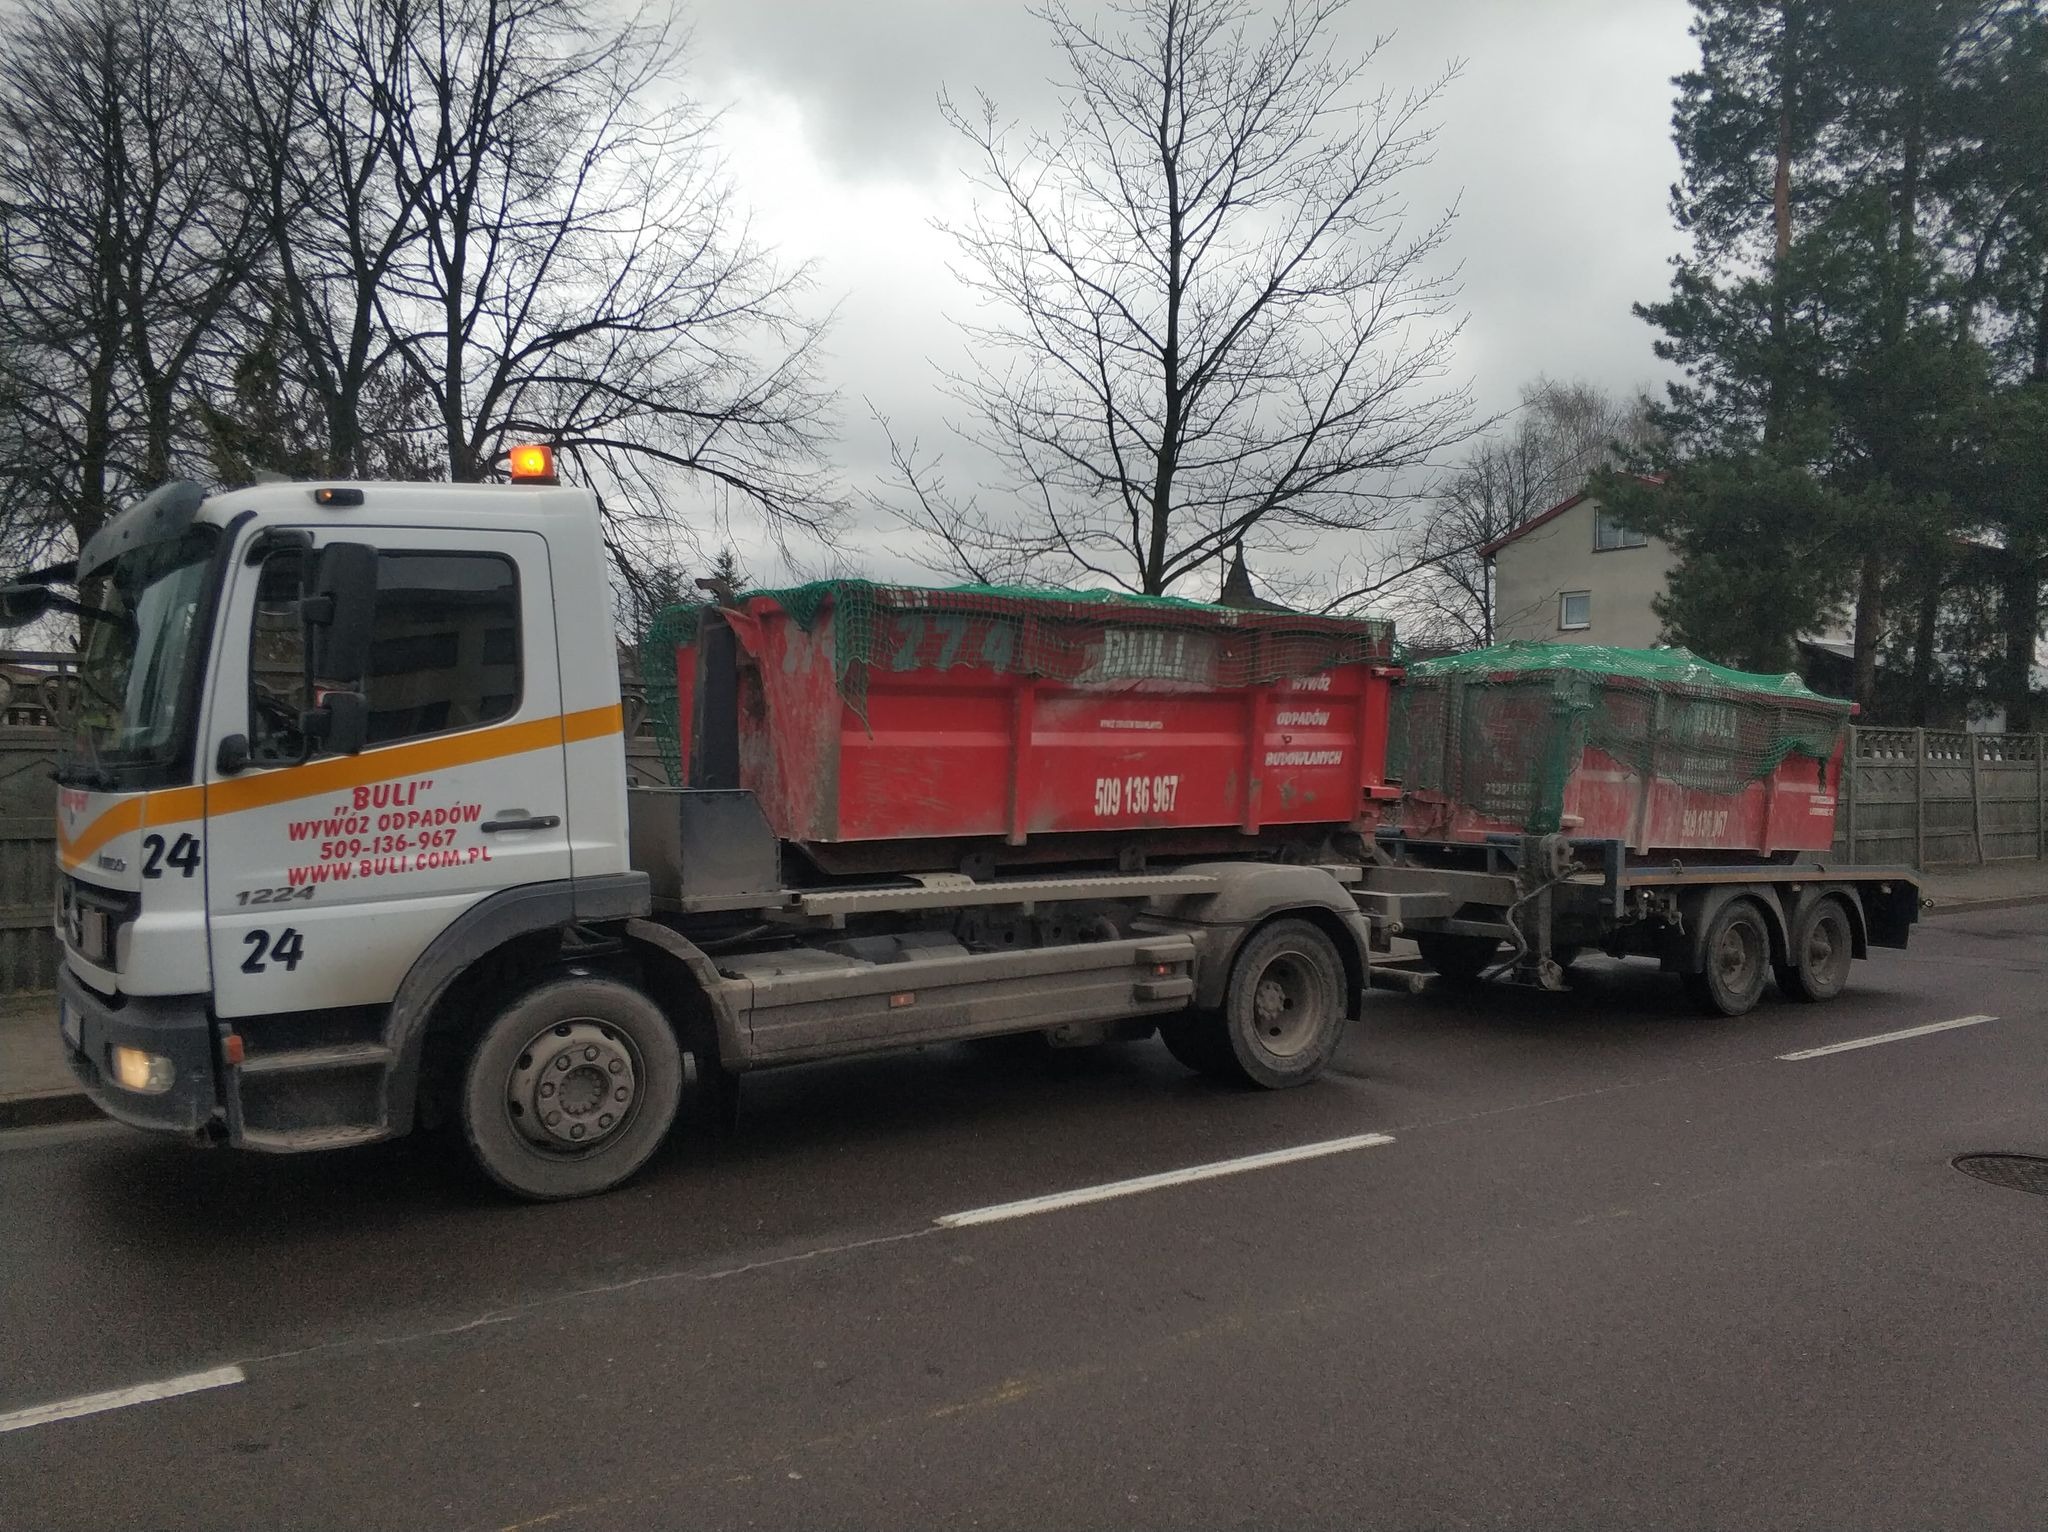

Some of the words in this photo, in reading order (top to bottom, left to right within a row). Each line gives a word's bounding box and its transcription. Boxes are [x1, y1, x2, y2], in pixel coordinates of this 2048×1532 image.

[1276, 709, 1330, 726] ODPADÓW
[1094, 777, 1121, 816] 509
[1125, 776, 1150, 814] 136
[1153, 775, 1179, 812] 967
[288, 815, 370, 841] WYWÓZ
[378, 801, 482, 832] ODPADÓW
[142, 832, 201, 879] 24
[320, 829, 457, 860] 509-136-967
[288, 846, 493, 886] WWW.BULI.COM.PL
[235, 885, 317, 906] 1224
[240, 927, 304, 974] 24
